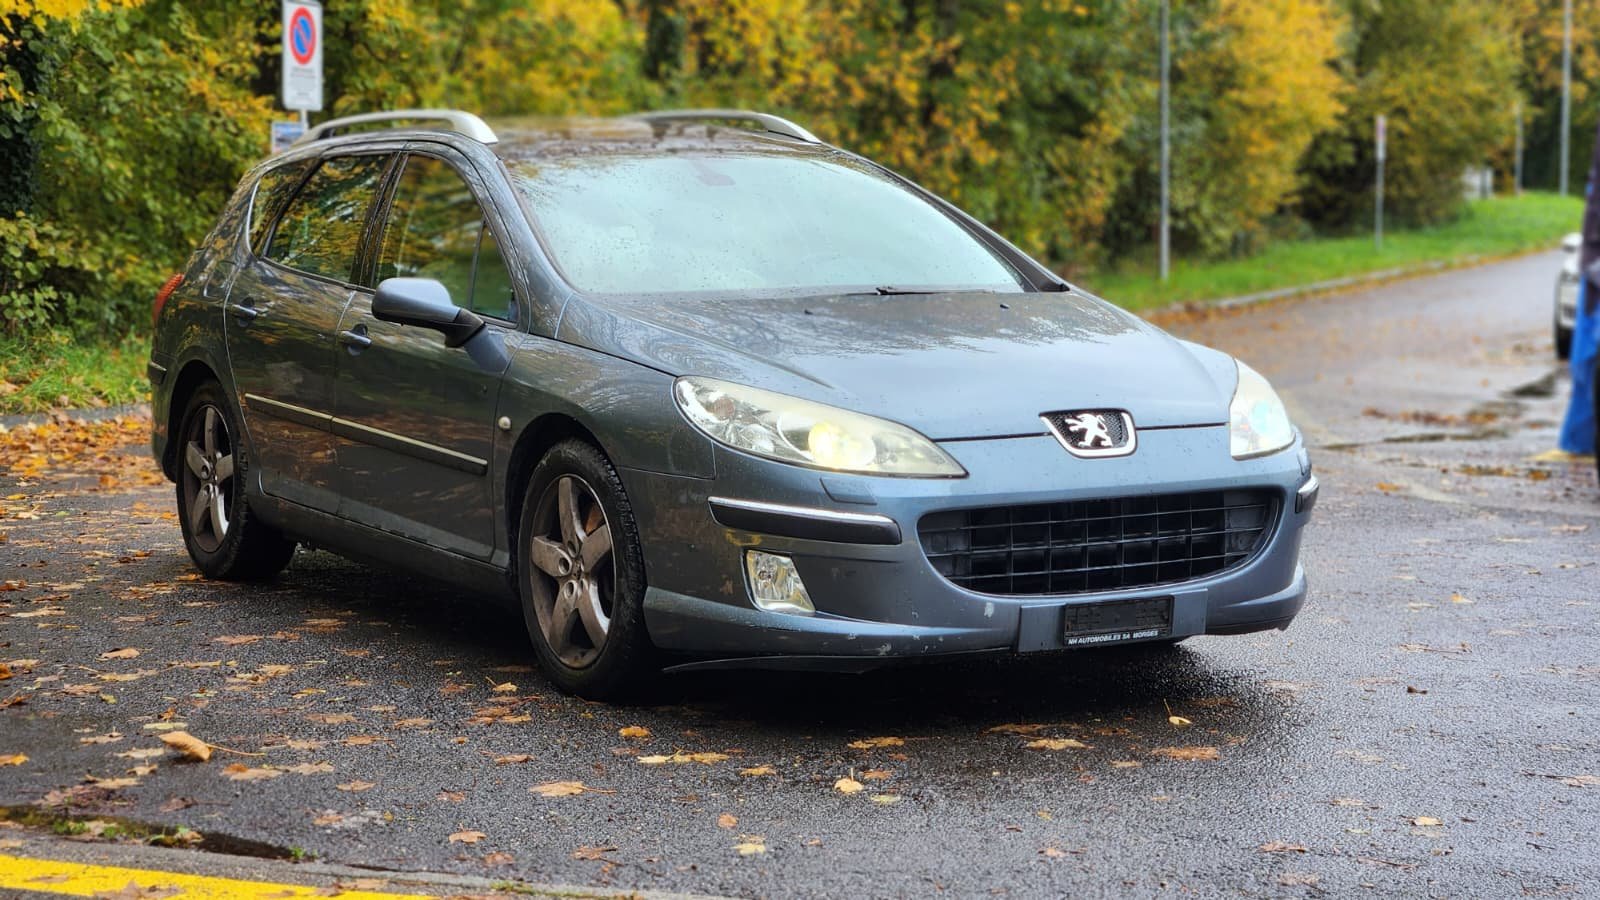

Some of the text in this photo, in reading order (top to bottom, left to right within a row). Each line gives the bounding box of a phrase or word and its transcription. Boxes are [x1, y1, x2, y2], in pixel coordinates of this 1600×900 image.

[1078, 634, 1121, 644] AUTOMOBILES
[1122, 632, 1130, 640] SA
[1132, 630, 1159, 639] MORGES
